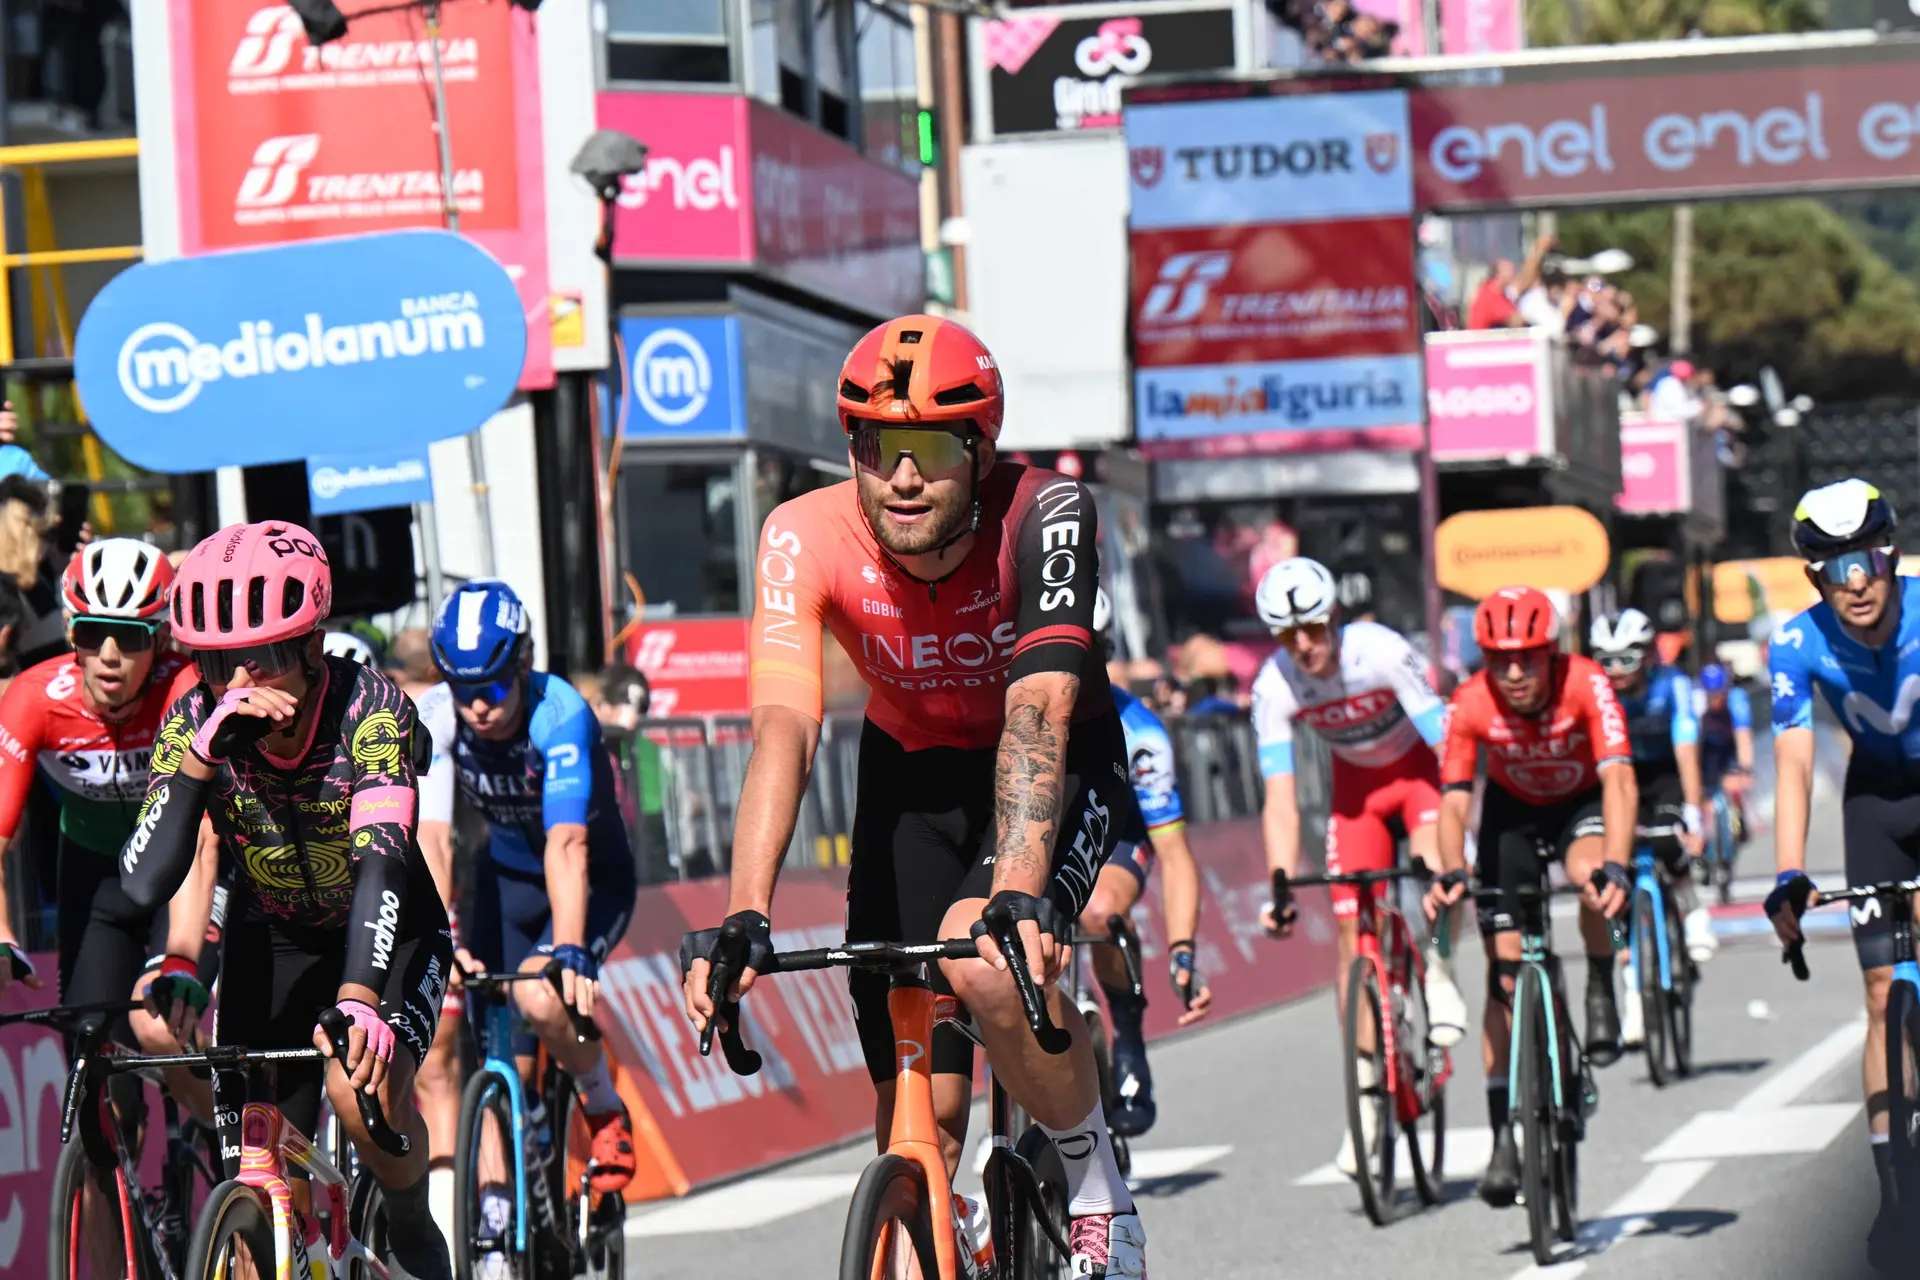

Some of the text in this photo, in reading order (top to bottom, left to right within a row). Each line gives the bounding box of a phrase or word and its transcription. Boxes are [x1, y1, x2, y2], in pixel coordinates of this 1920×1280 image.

[1430, 104, 1614, 181] enel
[1644, 91, 1829, 171] enel
[1175, 136, 1355, 181] TUDOR
[307, 169, 484, 202] TRENITAIA
[401, 290, 479, 319] BANCA
[118, 311, 485, 413] mediolanum
[1036, 481, 1080, 612] INEOS
[761, 523, 802, 651] INEOS
[862, 597, 904, 619] GOBIK
[956, 592, 1001, 615] PINARELLO
[860, 621, 1017, 670] INEOS
[98, 751, 150, 775] VISM
[299, 796, 351, 816] easypo
[1055, 788, 1111, 917] INEOS
[364, 889, 400, 971] wahoo
[826, 951, 854, 960] MO
[264, 1049, 318, 1059] cannondale
